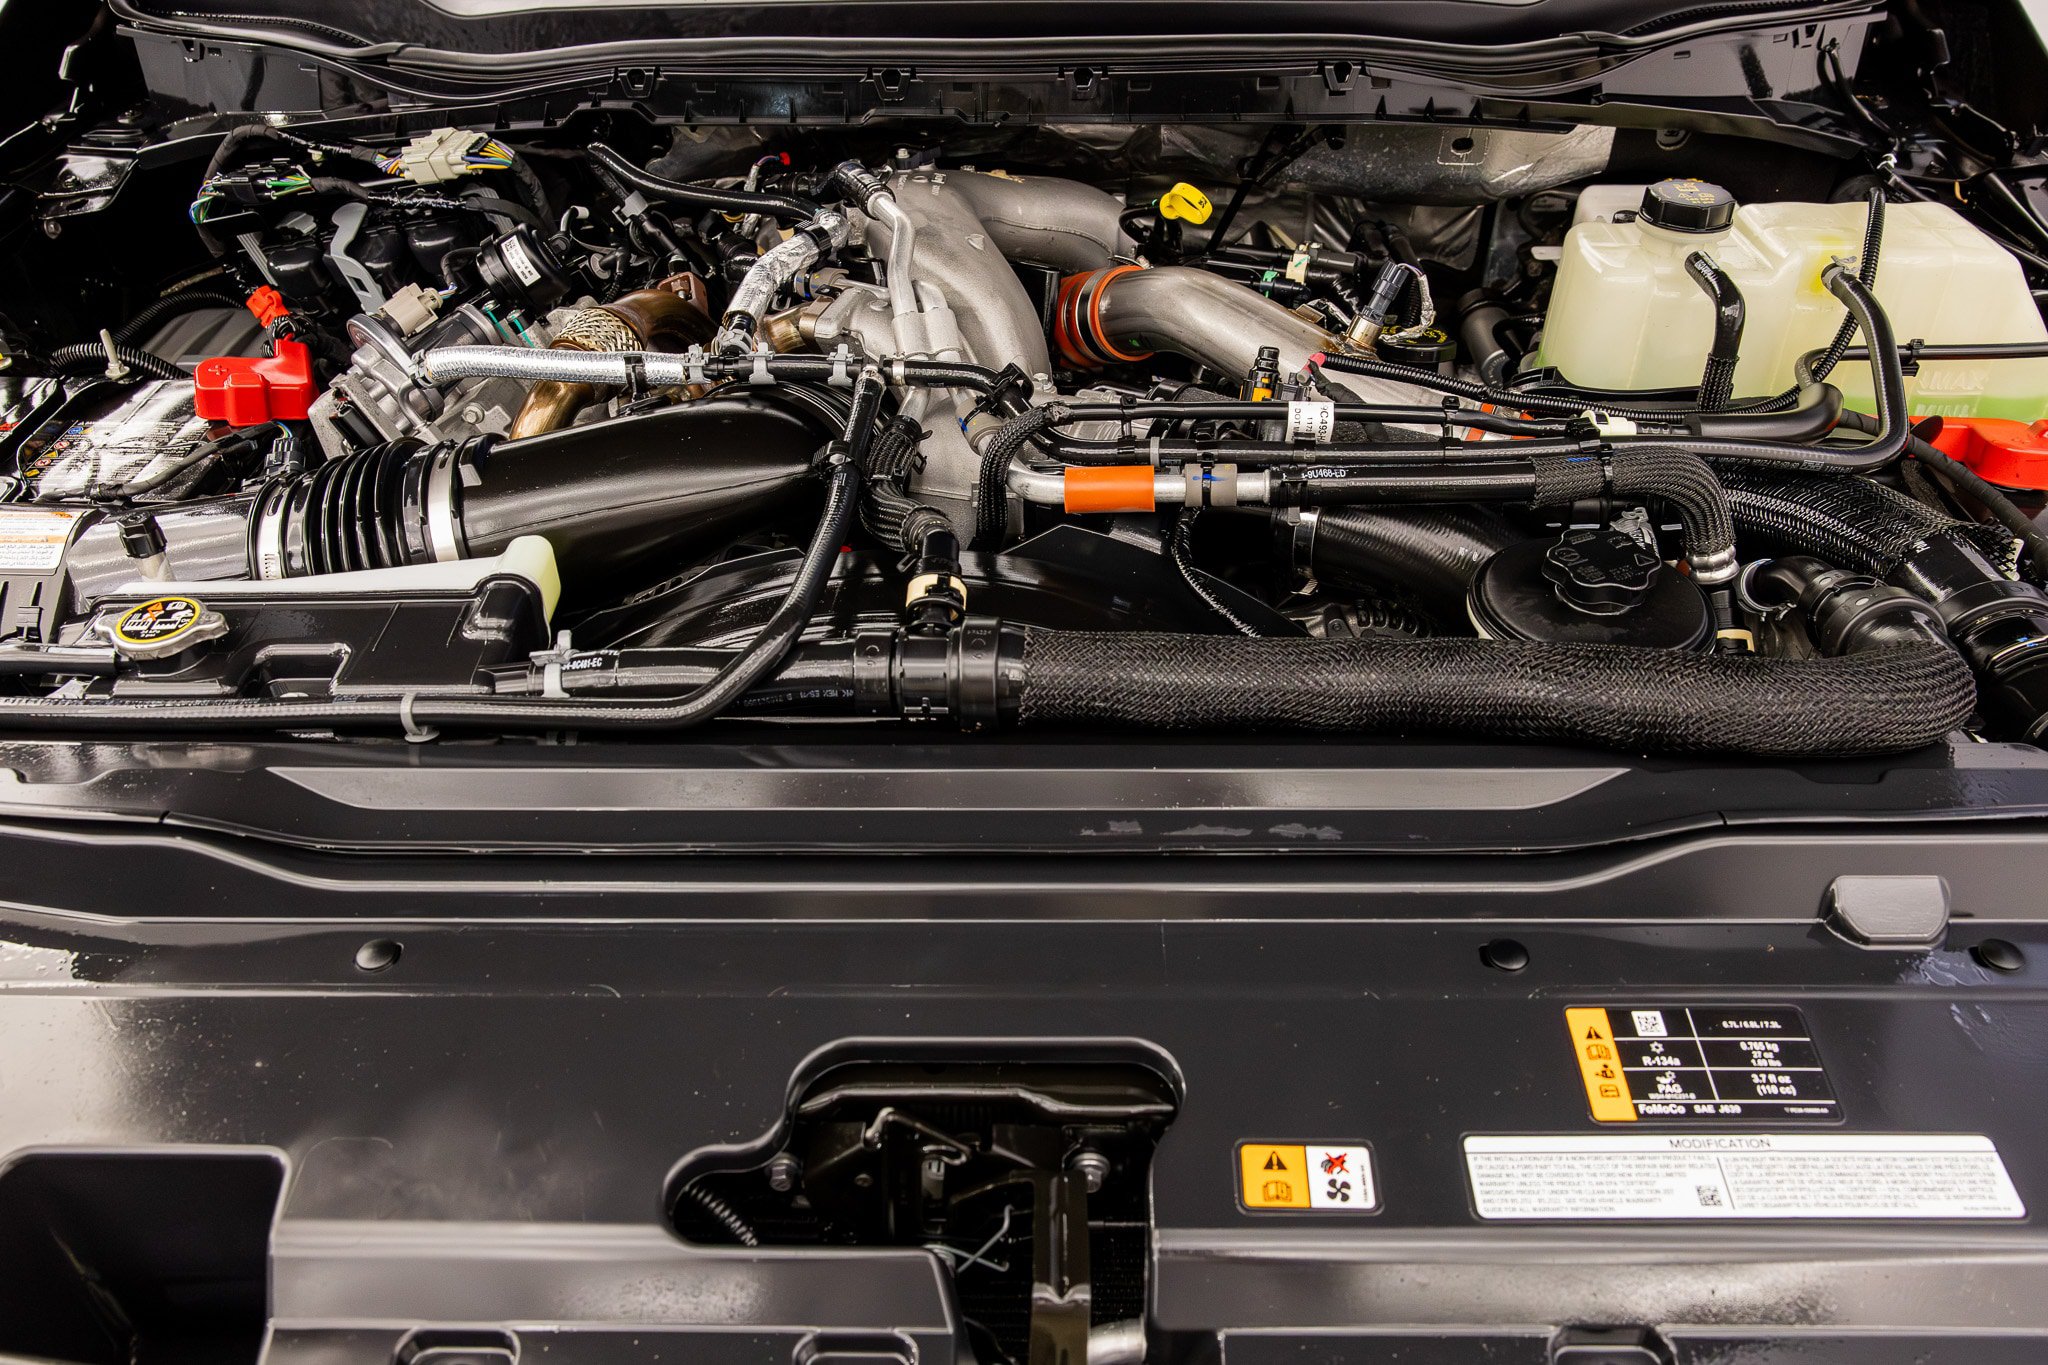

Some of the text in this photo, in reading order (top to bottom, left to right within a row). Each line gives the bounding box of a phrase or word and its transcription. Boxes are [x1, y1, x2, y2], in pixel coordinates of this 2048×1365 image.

[1765, 1041, 1780, 1053] kg
[1642, 1056, 1681, 1066] R-134a
[1751, 1074, 1767, 1083] 3.7
[1776, 1075, 1791, 1083] oz
[1657, 1083, 1683, 1093] PAG
[1756, 1084, 1797, 1096] (110 cc)
[1638, 1104, 1742, 1114] FoMoCo SAE J639
[1669, 1137, 1771, 1150] MODIFICATION
